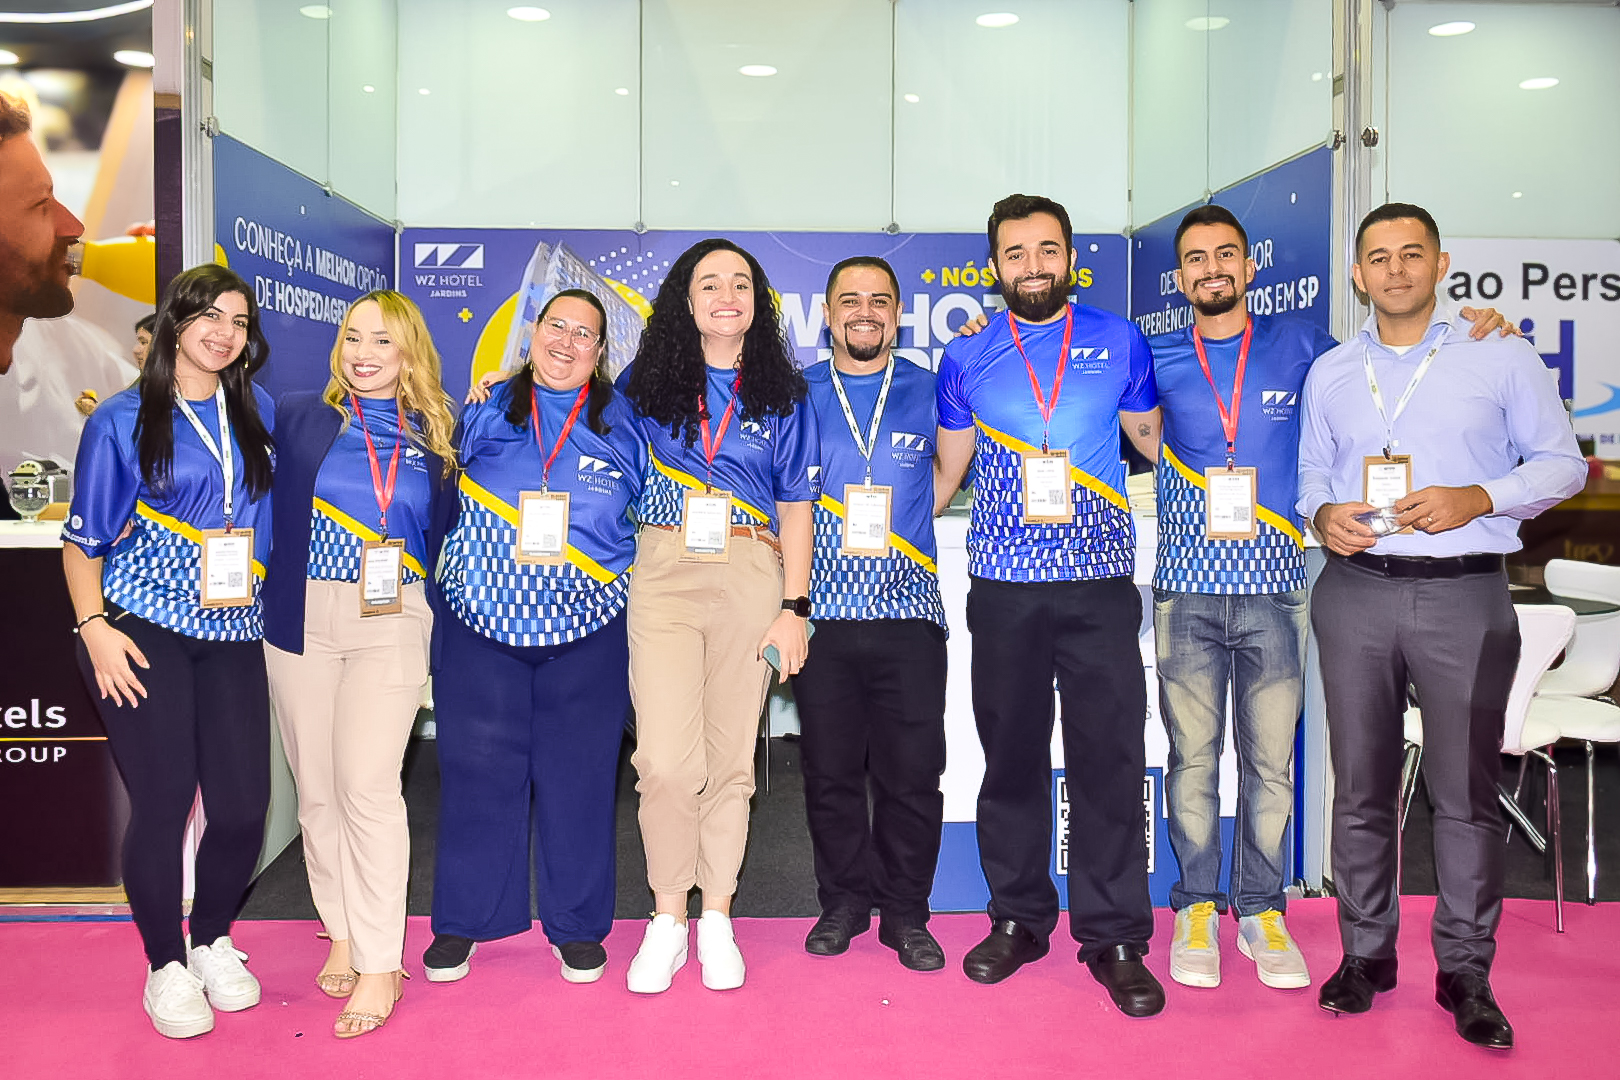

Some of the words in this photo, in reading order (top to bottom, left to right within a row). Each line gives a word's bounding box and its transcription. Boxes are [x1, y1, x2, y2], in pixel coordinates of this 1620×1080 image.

[234, 216, 303, 277] CONHEÇA
[304, 244, 314, 273] A
[315, 247, 356, 288] MELHOR
[255, 275, 274, 311] DE
[415, 274, 436, 286] WZ
[440, 274, 483, 287] HOTEL
[1275, 280, 1295, 313] EM
[1298, 275, 1319, 309] SP
[0, 698, 67, 728] els
[0, 746, 67, 763] OUP
